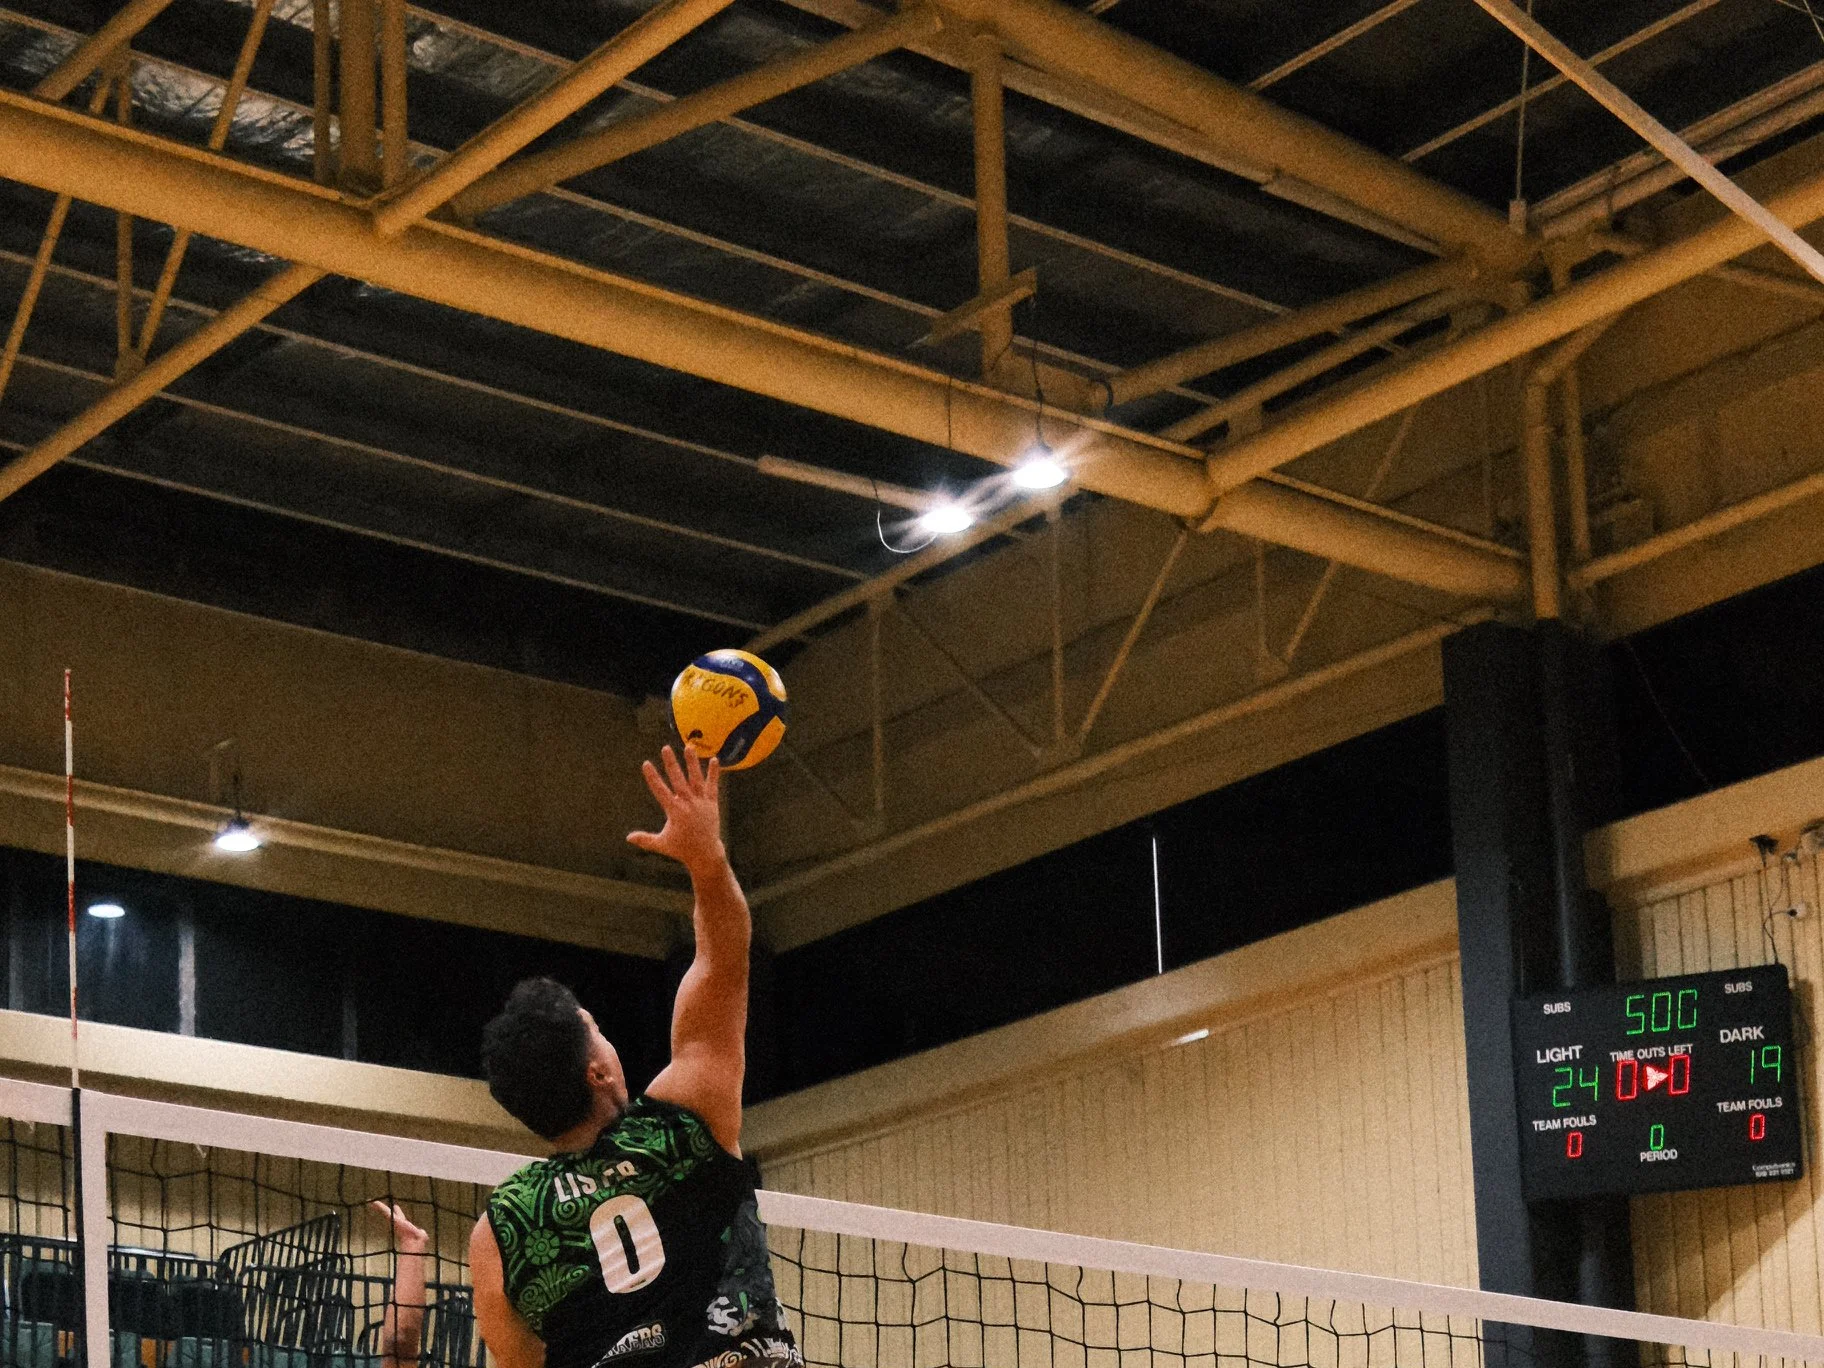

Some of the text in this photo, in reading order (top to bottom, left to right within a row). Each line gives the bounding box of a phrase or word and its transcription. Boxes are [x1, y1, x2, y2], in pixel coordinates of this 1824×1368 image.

[1724, 981, 1753, 994] SUBS
[1543, 1002, 1572, 1014] SUBS
[1626, 988, 1698, 1035] 500
[1719, 1026, 1765, 1044] DARK
[1536, 1045, 1584, 1064] LIGHT
[1609, 1043, 1694, 1062] TIME OUTS LEFT
[1750, 1045, 1782, 1085] 19
[1552, 1066, 1599, 1108] 24
[1616, 1053, 1691, 1101] 0 0
[1716, 1096, 1783, 1113] TEAM FOULS
[1532, 1114, 1597, 1131] TEAM FOULS
[1750, 1113, 1766, 1141] 0
[1566, 1131, 1583, 1158] 0
[1650, 1123, 1664, 1150] 0
[1640, 1149, 1678, 1163] PERIOD
[589, 1194, 666, 1294] 0
